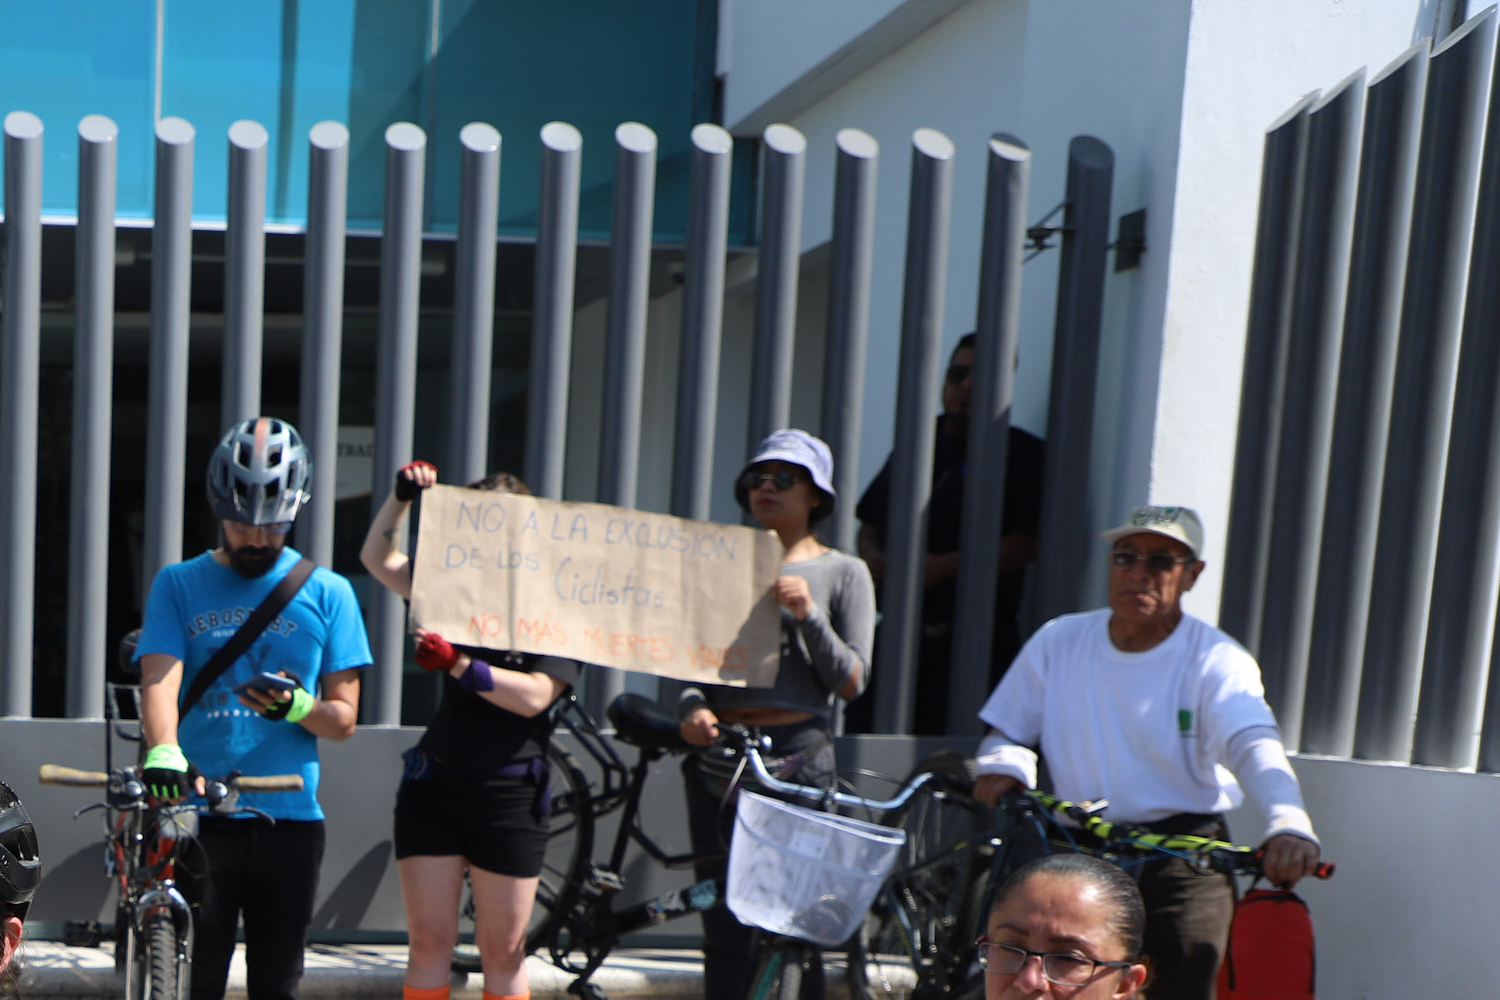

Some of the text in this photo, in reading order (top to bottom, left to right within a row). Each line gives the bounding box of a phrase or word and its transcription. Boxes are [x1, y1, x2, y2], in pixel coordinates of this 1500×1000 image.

[457, 501, 507, 534] NO
[521, 510, 540, 536] A
[550, 513, 589, 542] LA
[445, 543, 485, 570] DE
[496, 550, 541, 572] LOS
[467, 610, 503, 639] NO
